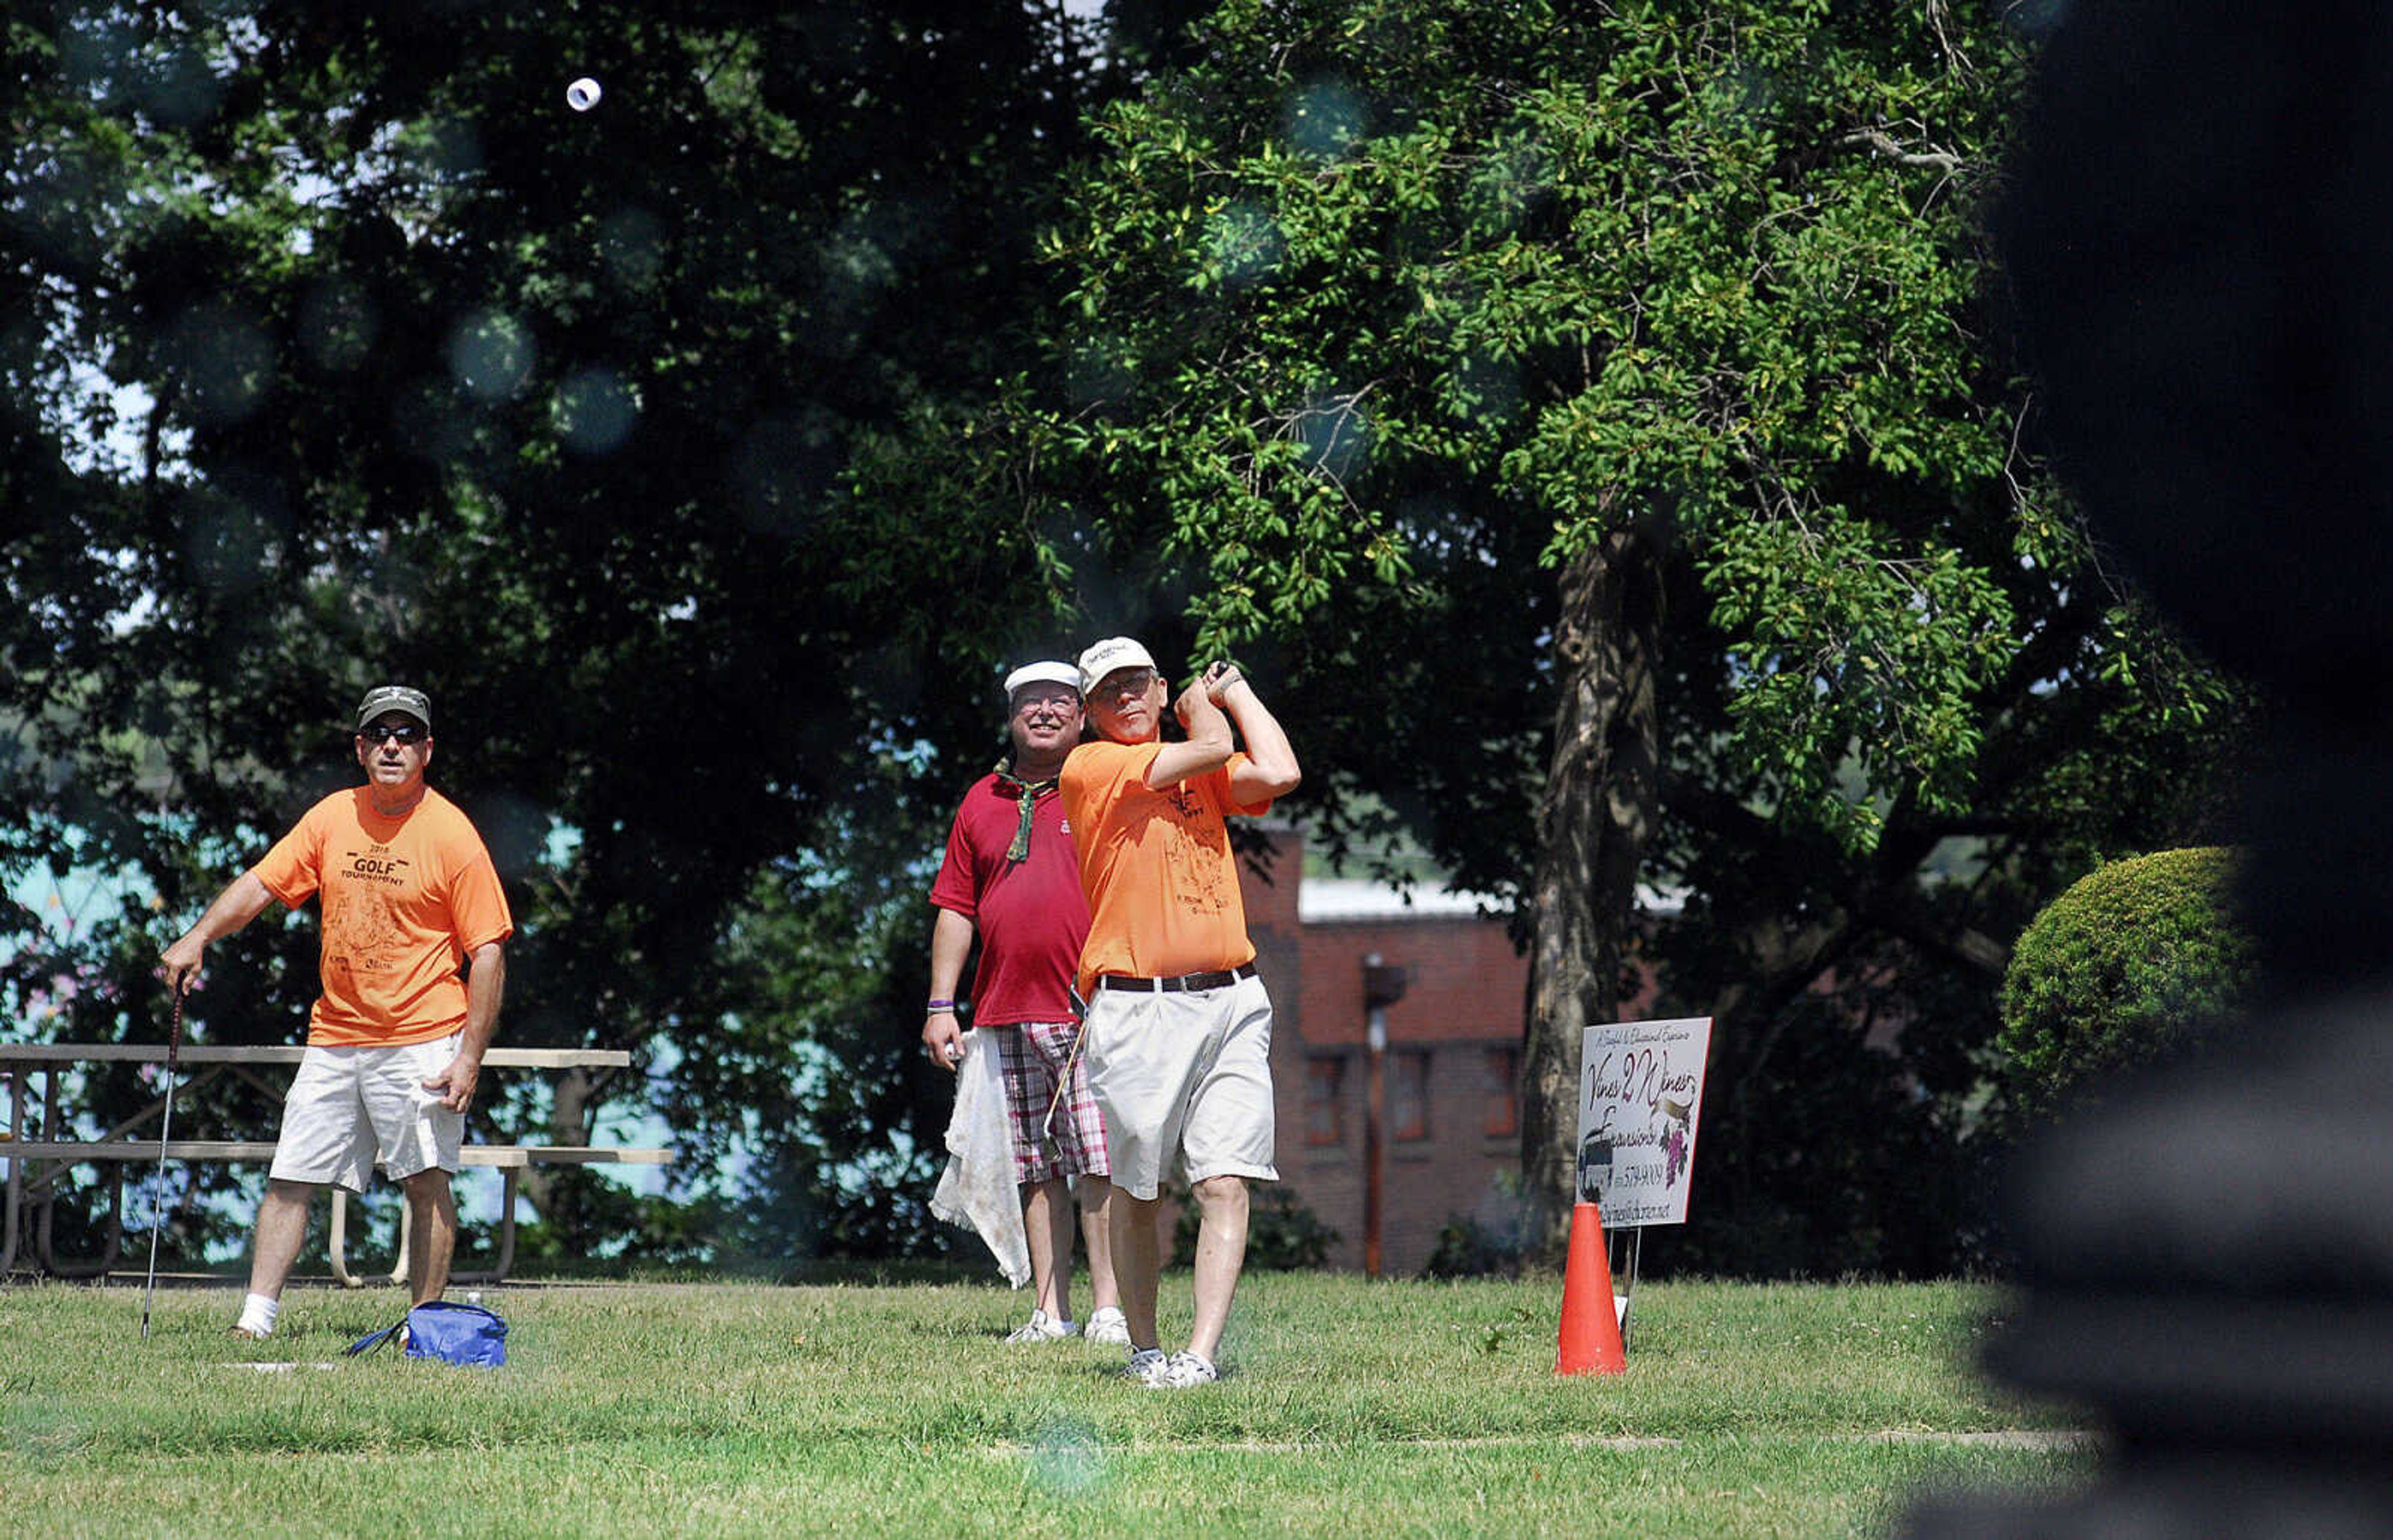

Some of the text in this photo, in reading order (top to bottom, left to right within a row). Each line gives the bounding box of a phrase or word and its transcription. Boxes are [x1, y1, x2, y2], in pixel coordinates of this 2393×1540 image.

[354, 858, 396, 875] GOLF
[341, 870, 404, 886] TOURNAMENT
[1588, 1048, 1689, 1111] Vines 2 Wines
